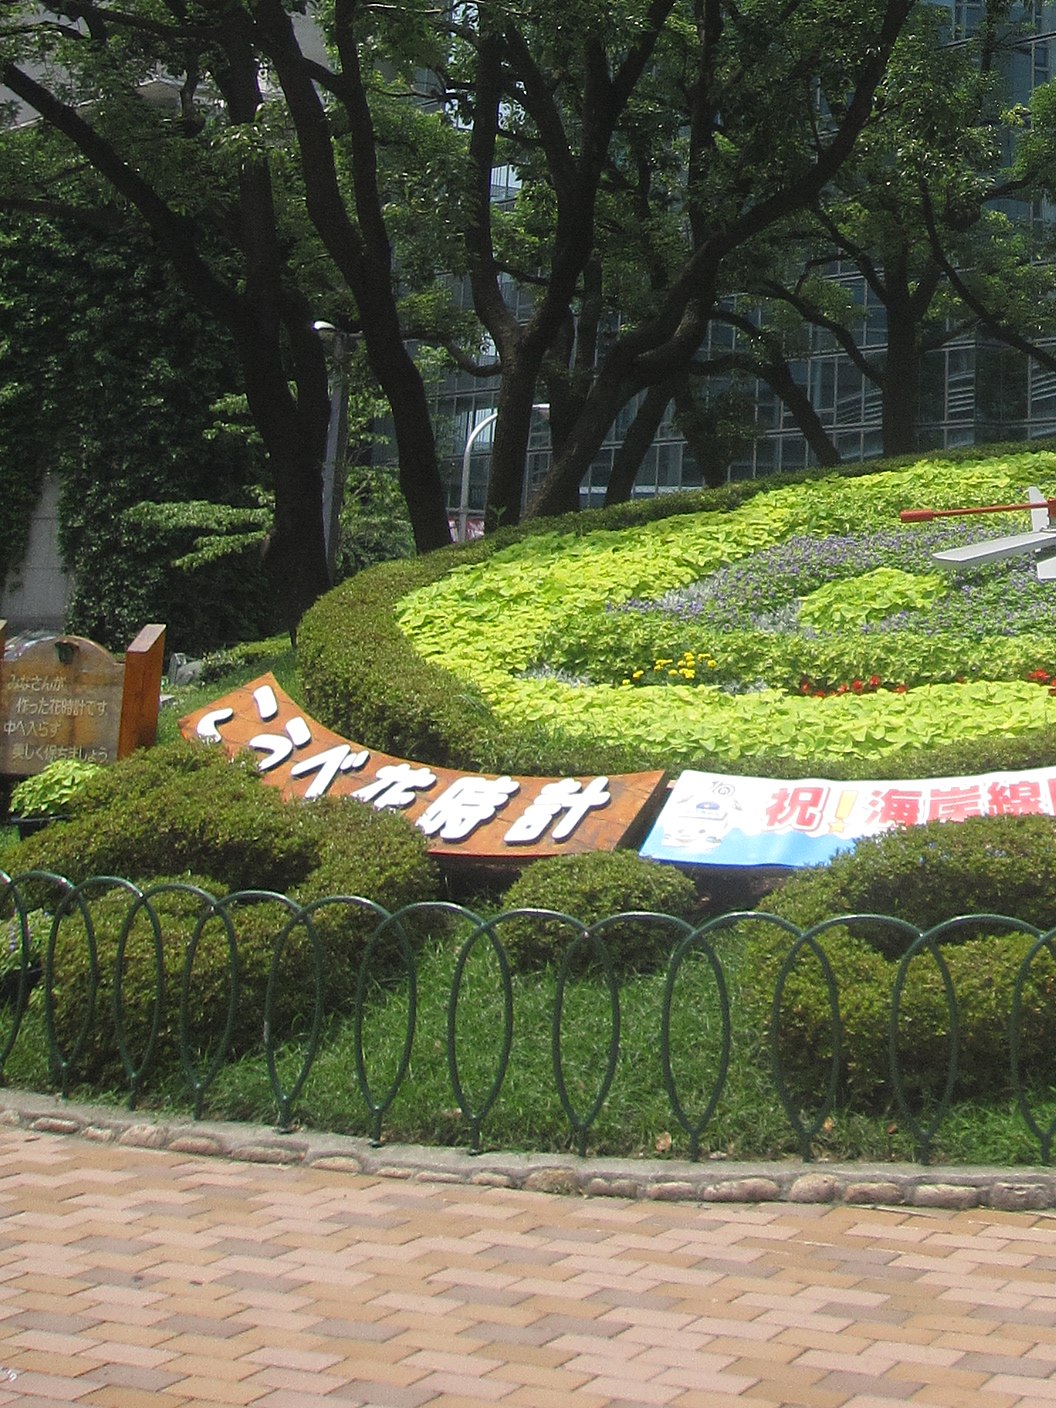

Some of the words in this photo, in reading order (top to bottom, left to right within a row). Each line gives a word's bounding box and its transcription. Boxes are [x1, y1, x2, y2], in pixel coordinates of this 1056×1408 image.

[7, 674, 67, 692] みなさんが
[3, 720, 62, 738] 中へ入らず
[196, 684, 612, 845] こうべ花時計
